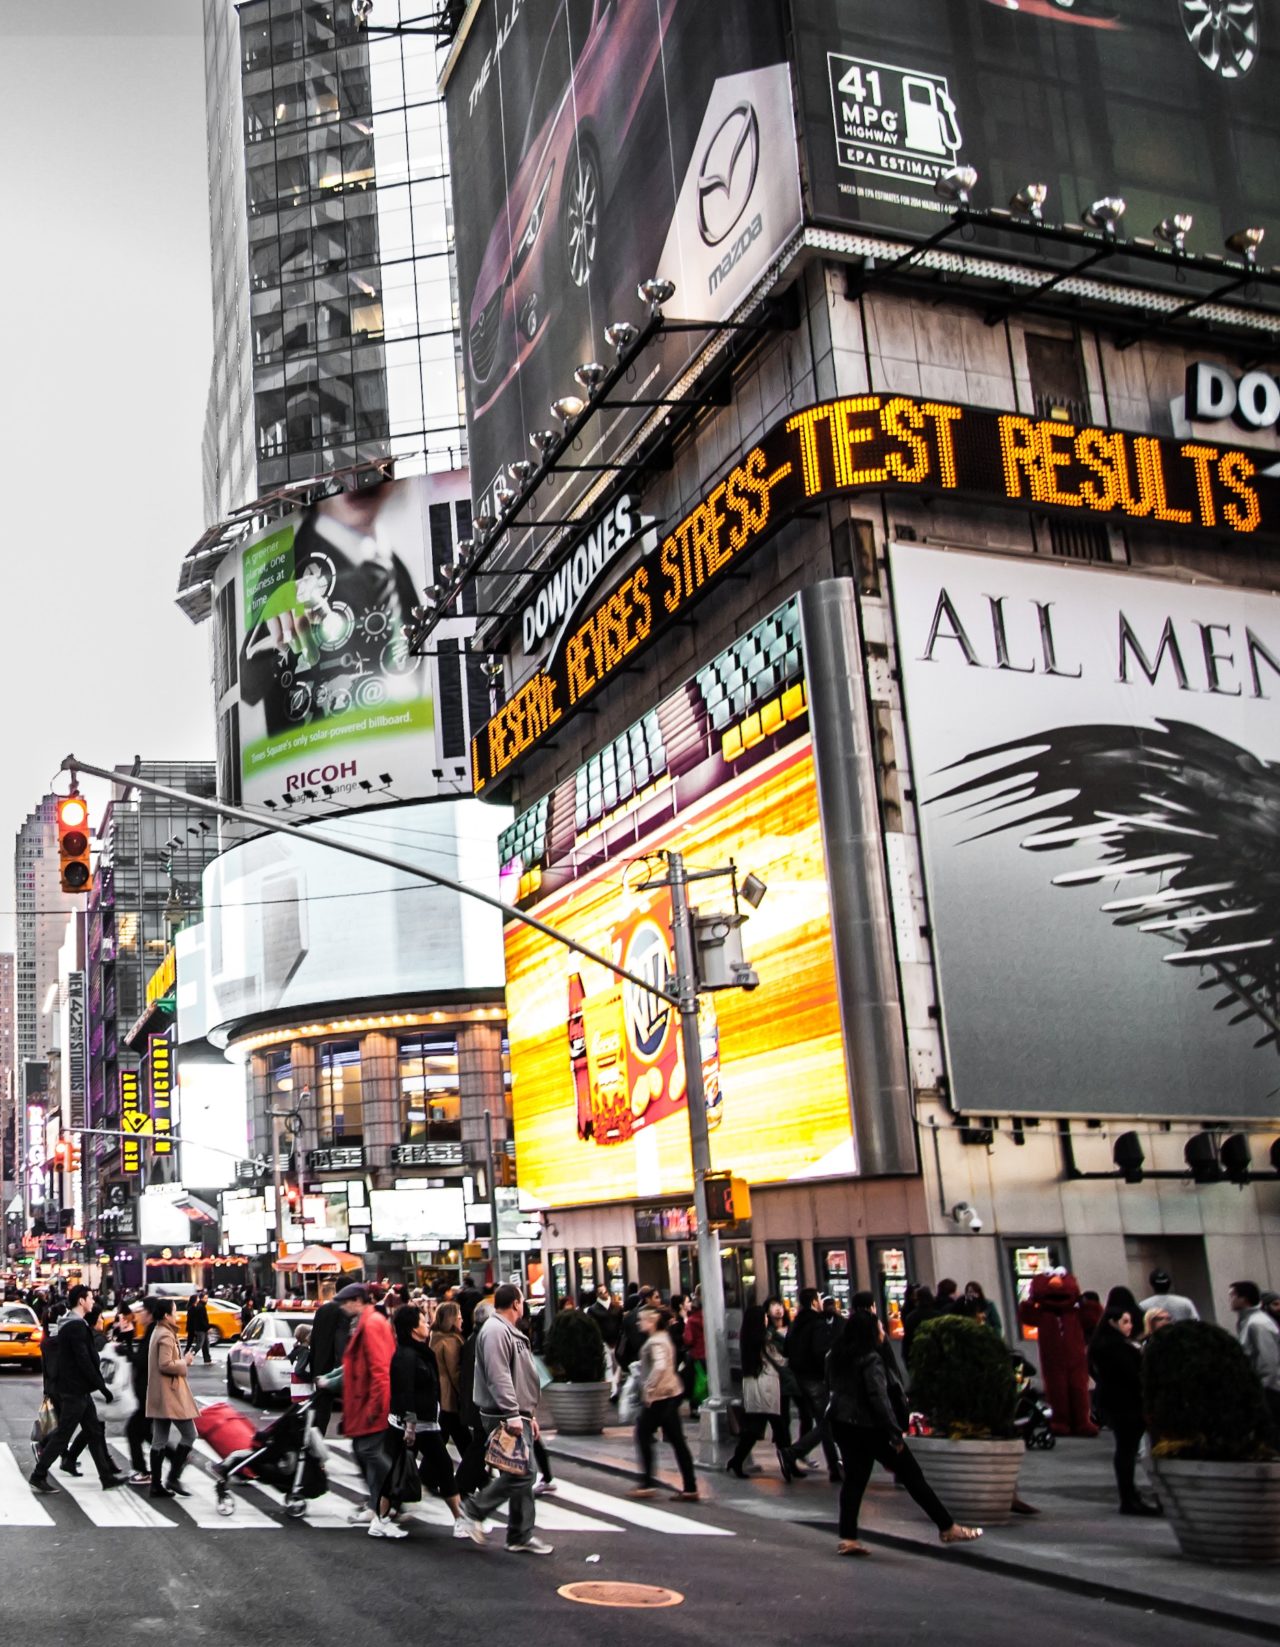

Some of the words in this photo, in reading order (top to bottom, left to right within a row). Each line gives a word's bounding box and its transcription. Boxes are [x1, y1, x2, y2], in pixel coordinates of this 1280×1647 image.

[838, 66, 882, 107] 41
[844, 125, 898, 145] HIGHWAY
[847, 148, 875, 165] EPA
[708, 213, 763, 296] mazda
[270, 554, 286, 568] one
[566, 566, 651, 705] REVISES
[998, 414, 1262, 533] RESULTS
[915, 587, 1082, 678] ALL
[293, 734, 308, 748] only
[309, 719, 367, 743] solar-powered
[368, 712, 413, 730] billboard.
[286, 760, 357, 793] RICOH
[153, 1038, 170, 1108] VICTORY
